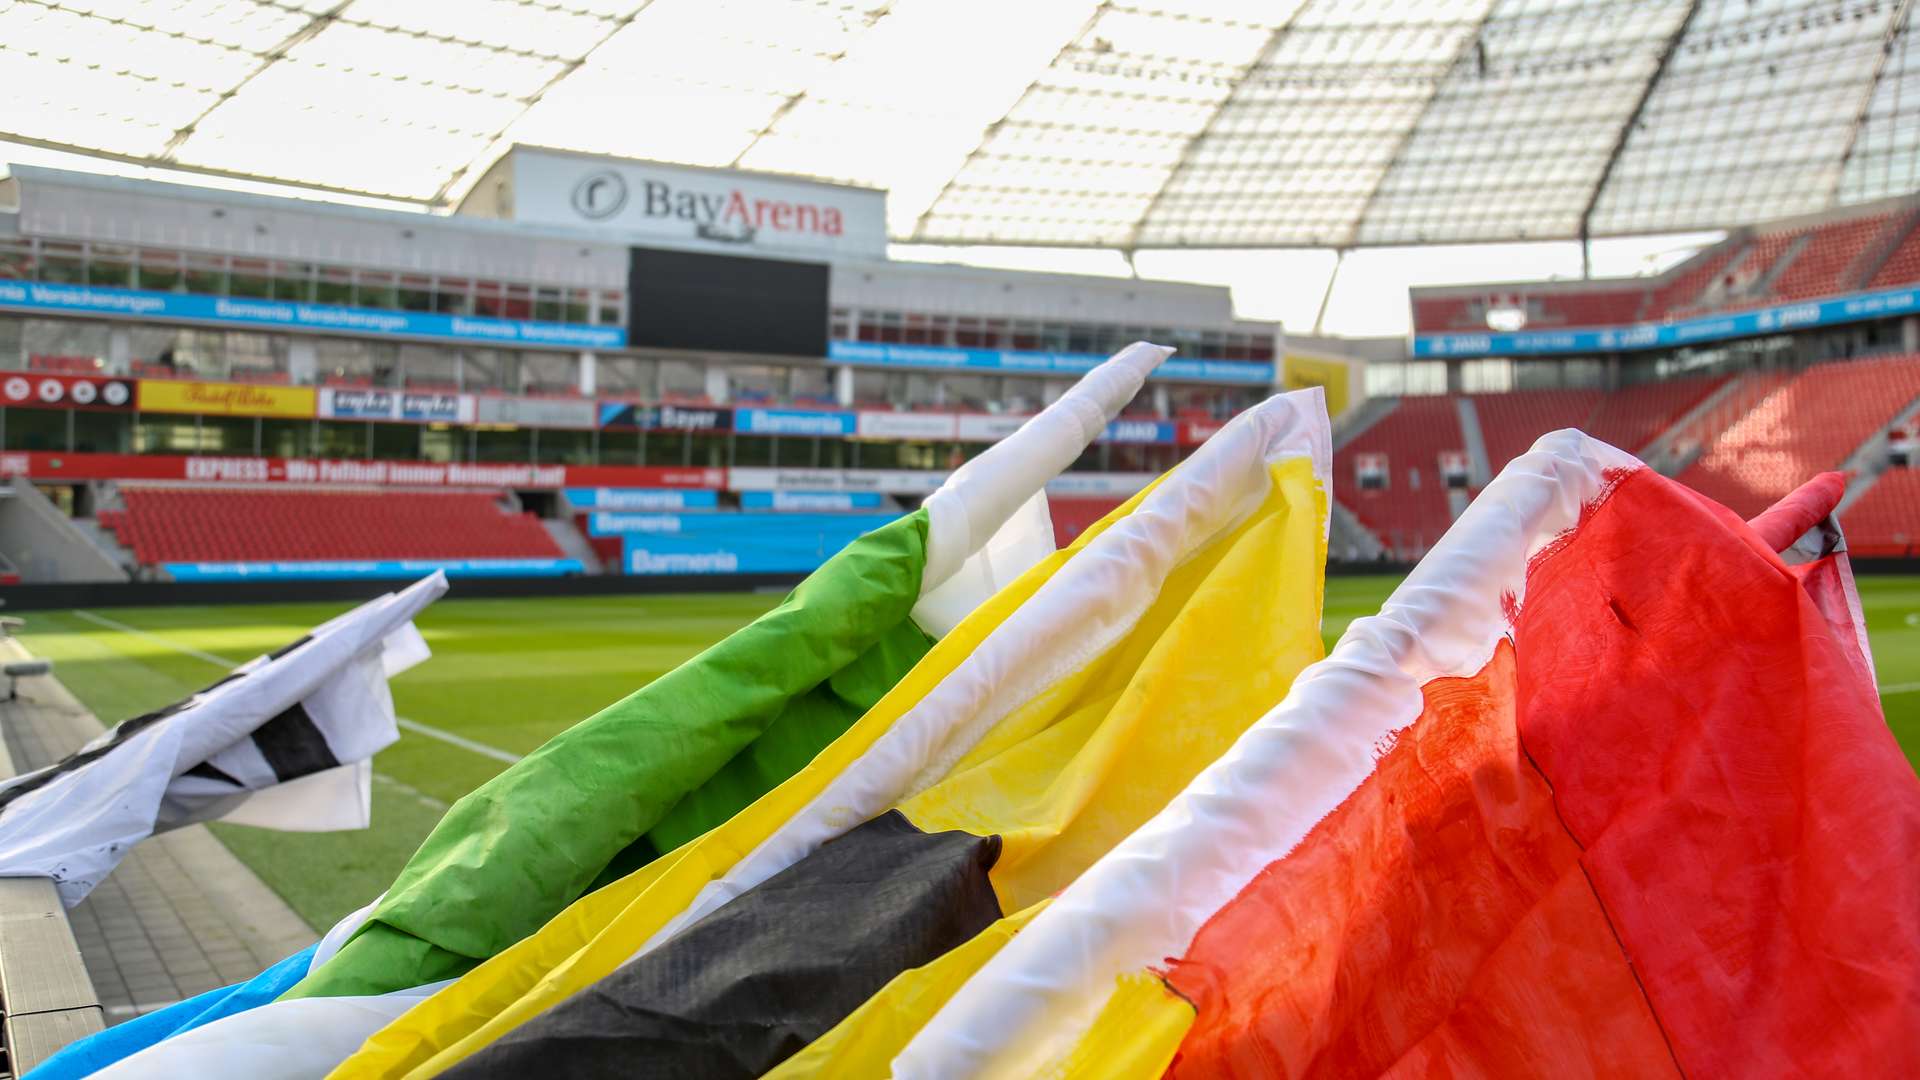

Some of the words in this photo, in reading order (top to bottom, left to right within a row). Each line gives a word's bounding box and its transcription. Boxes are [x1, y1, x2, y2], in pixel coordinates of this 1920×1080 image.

[642, 179, 844, 237] BayArena
[215, 298, 293, 321] Barmenia
[660, 407, 717, 430] Bayer
[750, 410, 844, 432] Barmenia
[186, 456, 269, 481] EXPRESS
[595, 487, 684, 508] Barmenia
[595, 512, 681, 532] Barmenia
[631, 548, 738, 573] Barmenia
